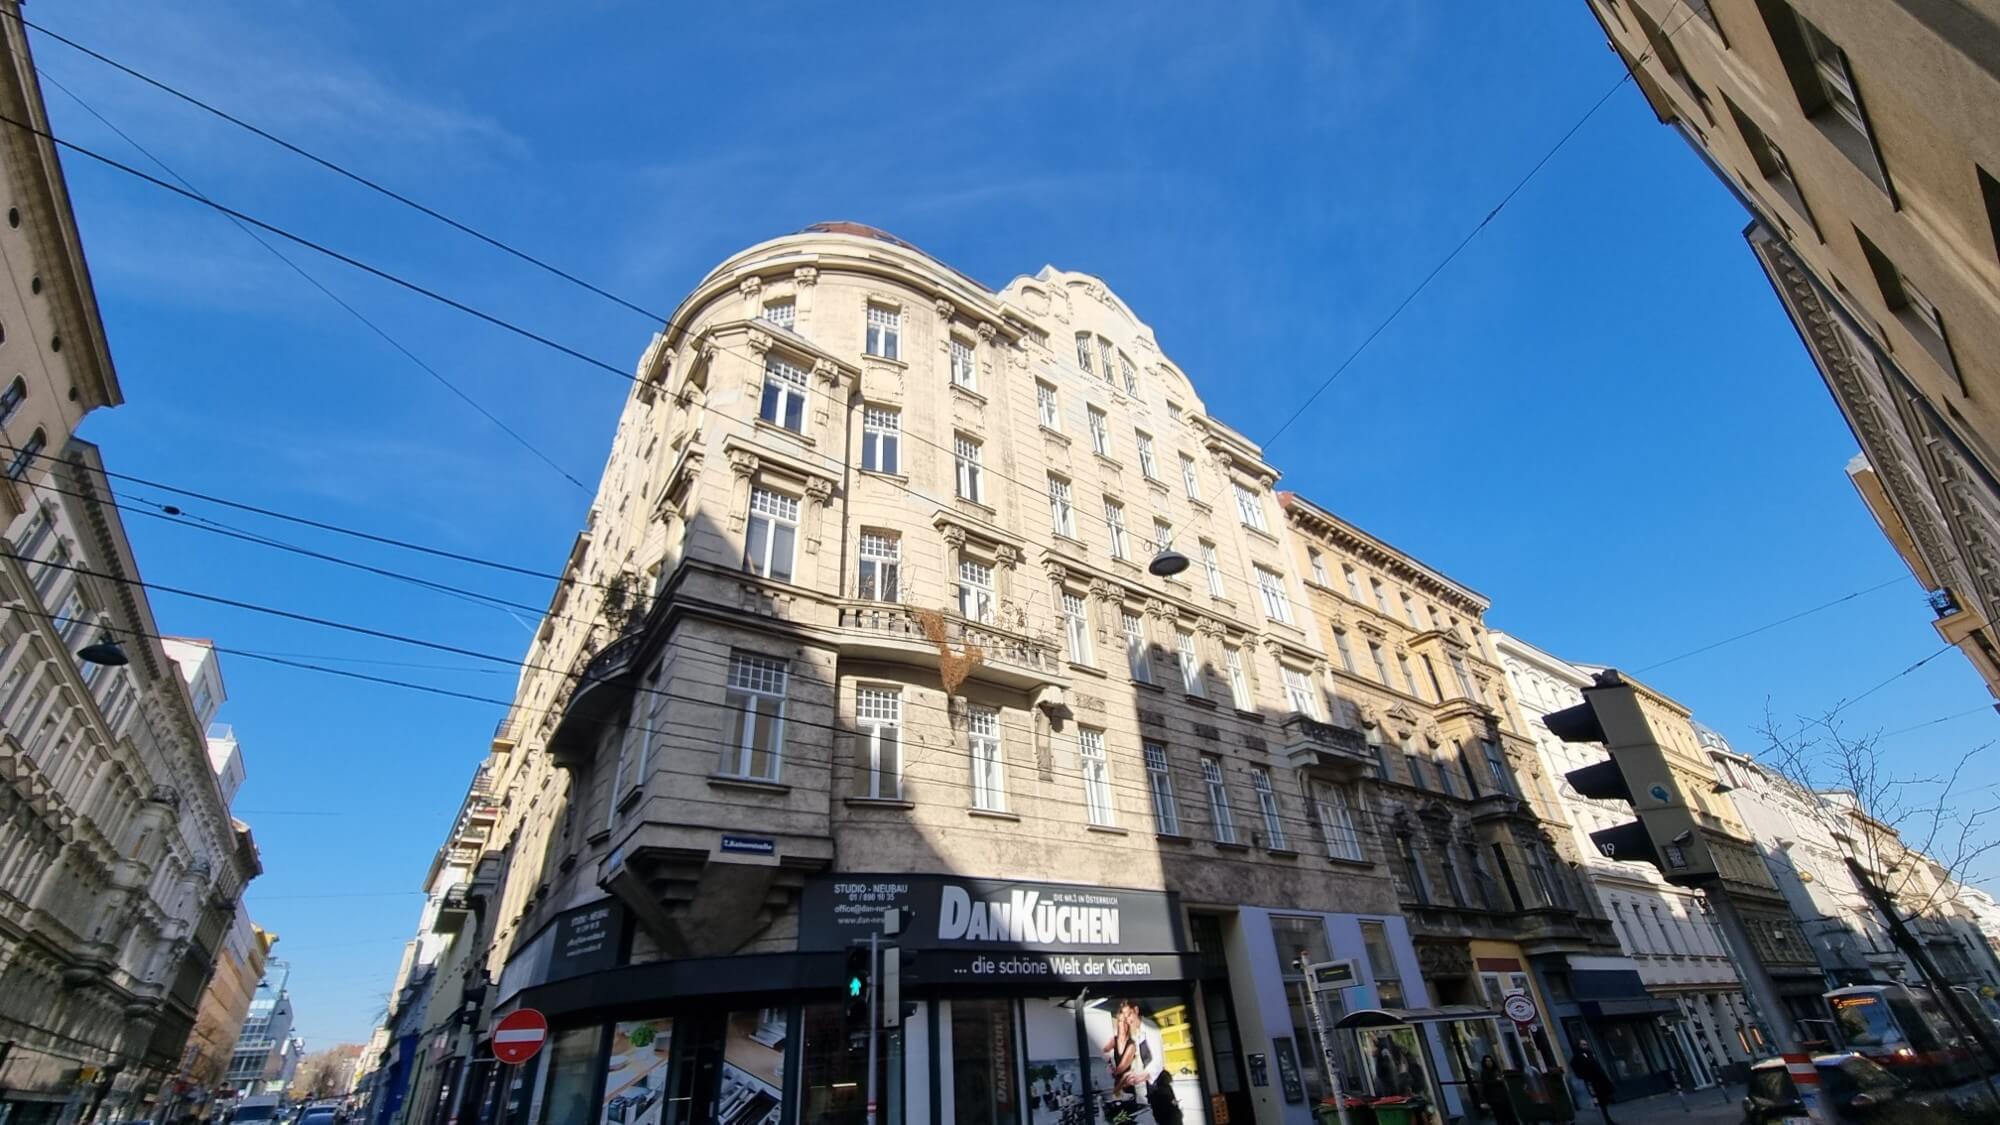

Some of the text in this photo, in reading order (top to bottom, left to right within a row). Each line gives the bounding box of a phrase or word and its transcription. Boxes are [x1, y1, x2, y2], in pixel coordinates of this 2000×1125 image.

[1601, 843, 1615, 857] 19
[834, 884, 866, 894] STUDIO
[873, 884, 908, 893] NEUBAU
[1053, 893, 1063, 902] DIE
[1078, 895, 1085, 903] IN
[1086, 895, 1118, 905] ÖSTERREICH
[972, 955, 995, 974] die
[1000, 956, 1047, 975] schöne
[1050, 957, 1080, 976] Welt
[1083, 957, 1104, 976] der
[1107, 958, 1151, 976] Küchen
